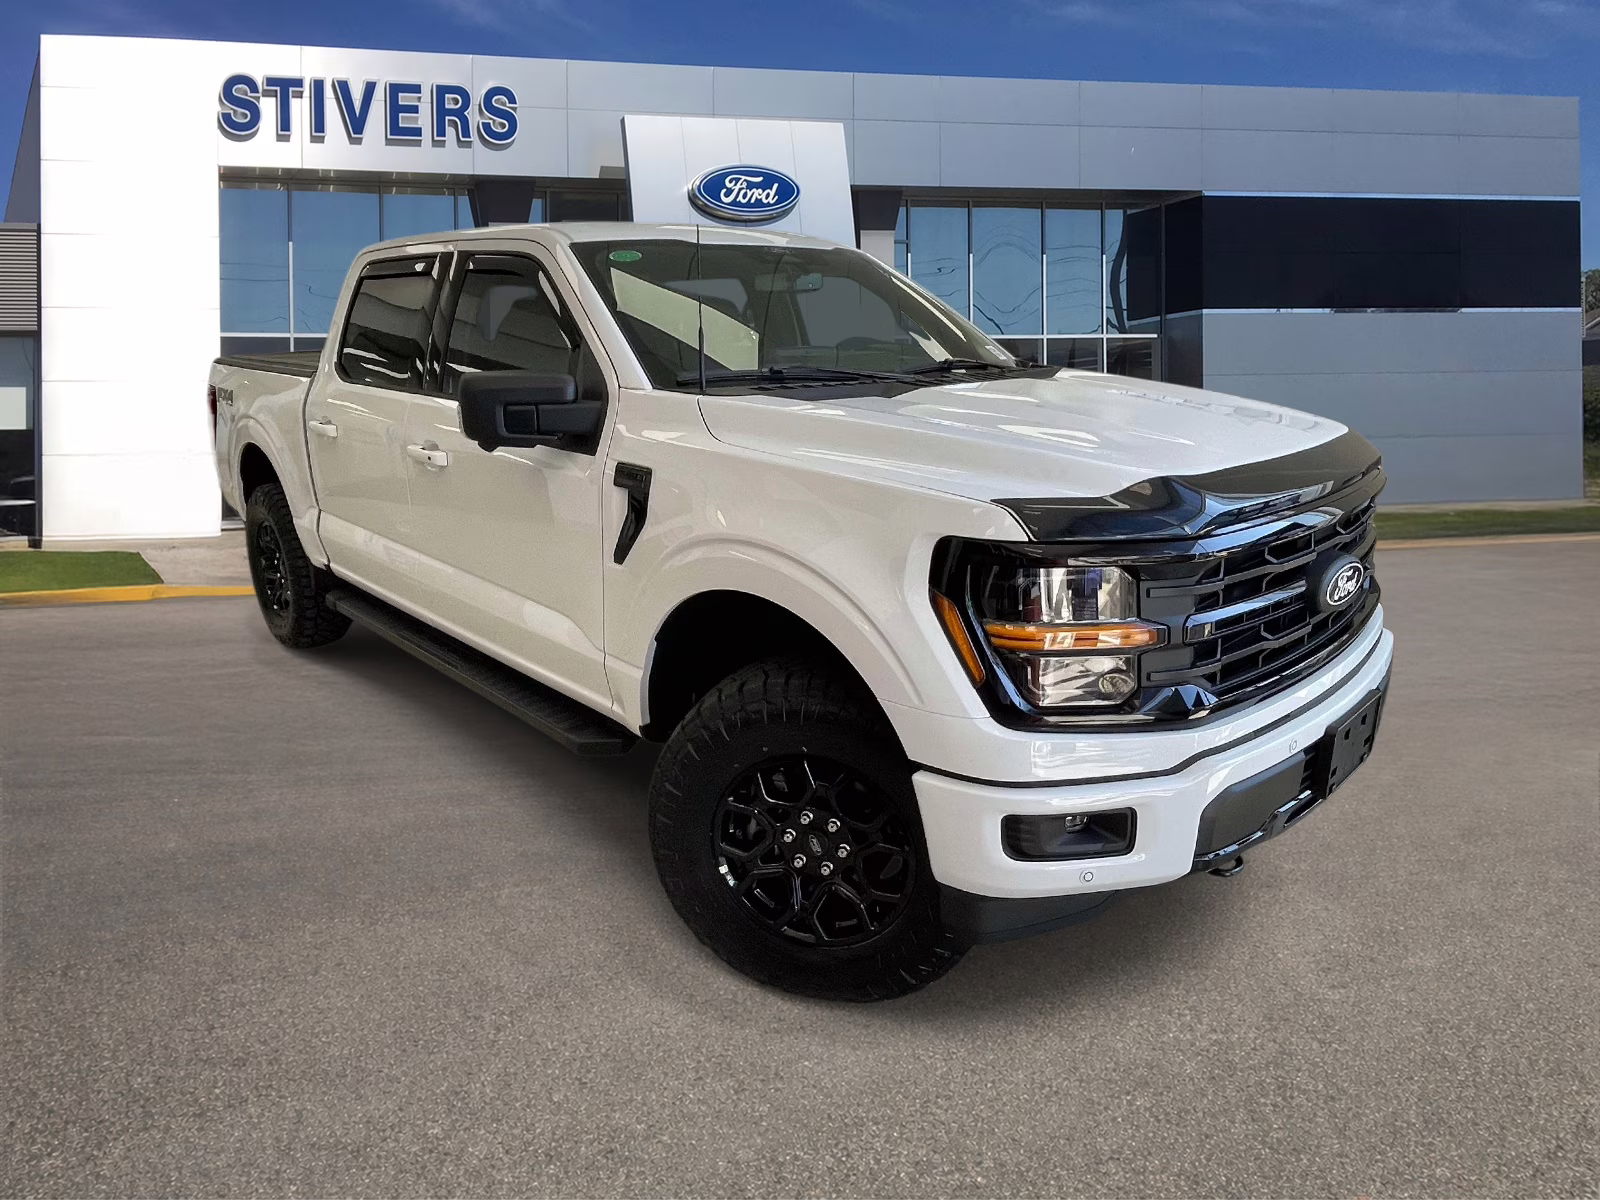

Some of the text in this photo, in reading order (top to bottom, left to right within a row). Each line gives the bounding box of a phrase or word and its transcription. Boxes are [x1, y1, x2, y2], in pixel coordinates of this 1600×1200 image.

[218, 73, 518, 148] STIVERS
[720, 174, 779, 204] Ford
[1334, 568, 1358, 600] Ford
